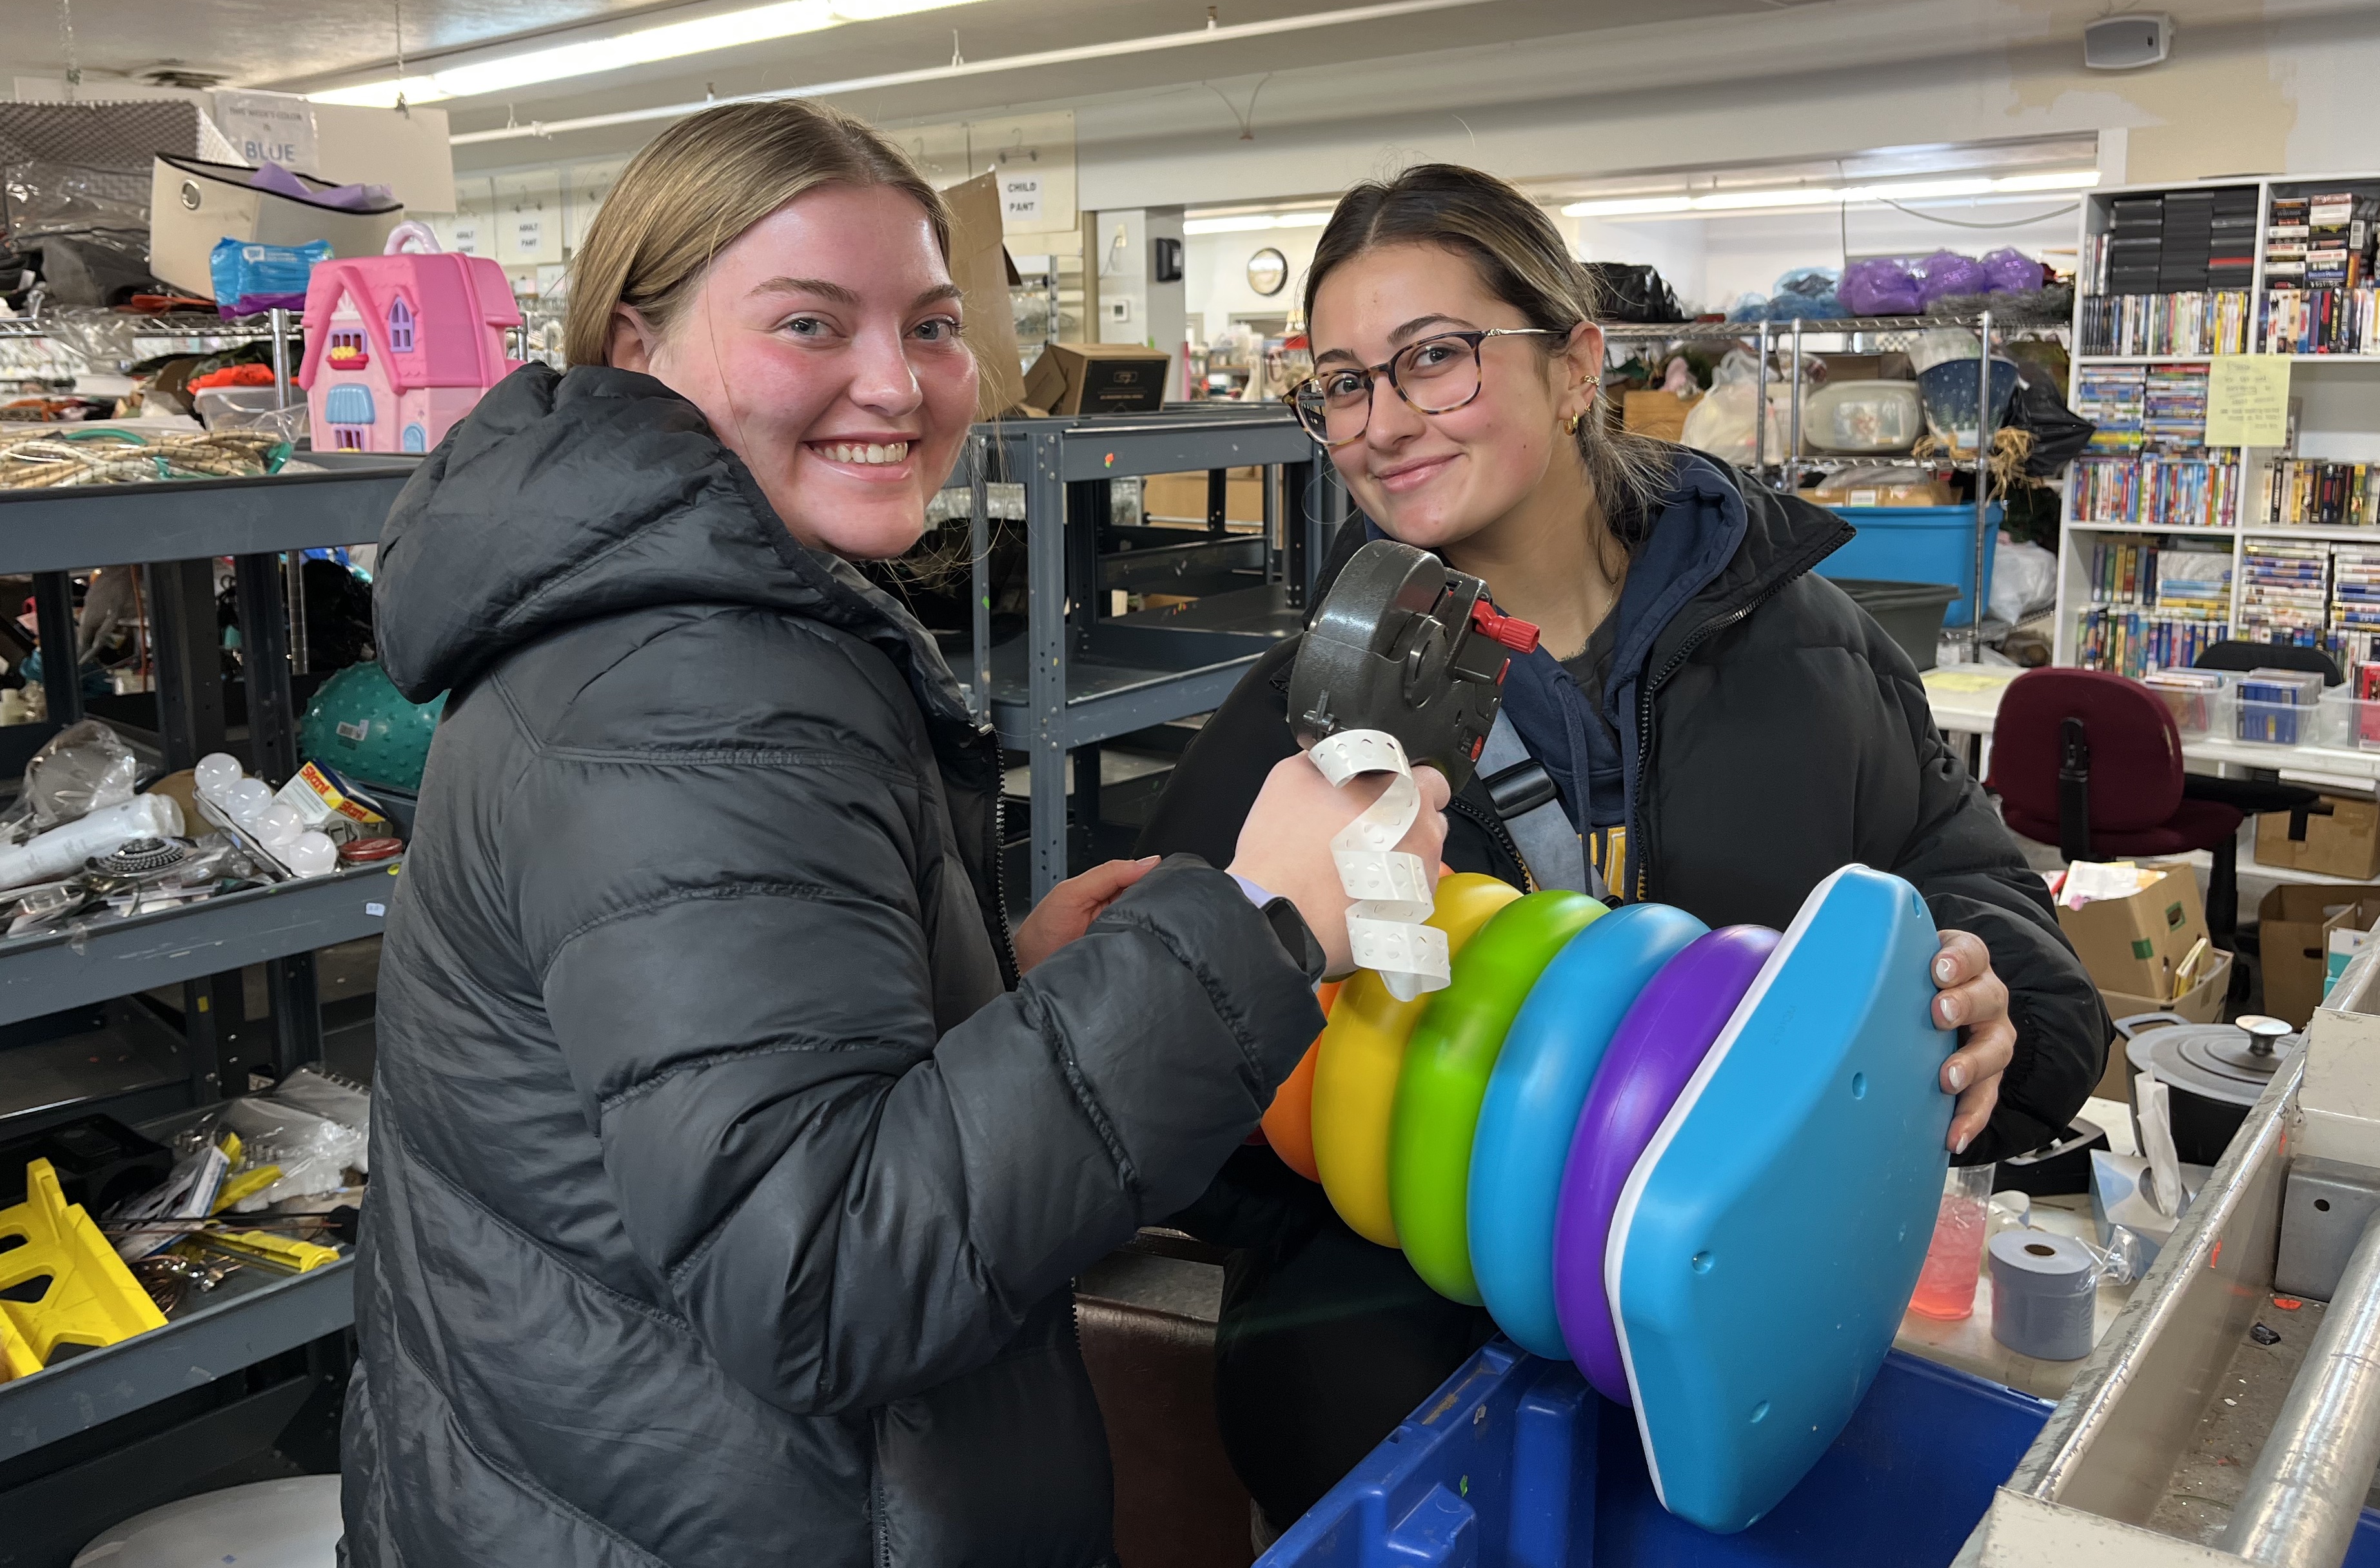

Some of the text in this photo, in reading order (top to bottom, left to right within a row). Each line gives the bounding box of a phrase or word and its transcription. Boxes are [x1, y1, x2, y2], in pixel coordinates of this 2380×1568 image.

[245, 141, 295, 162] BLUE
[1007, 182, 1037, 193] CHILD
[1009, 202, 1034, 212] PANT
[301, 765, 330, 796] Stant
[339, 800, 369, 821] Stant
